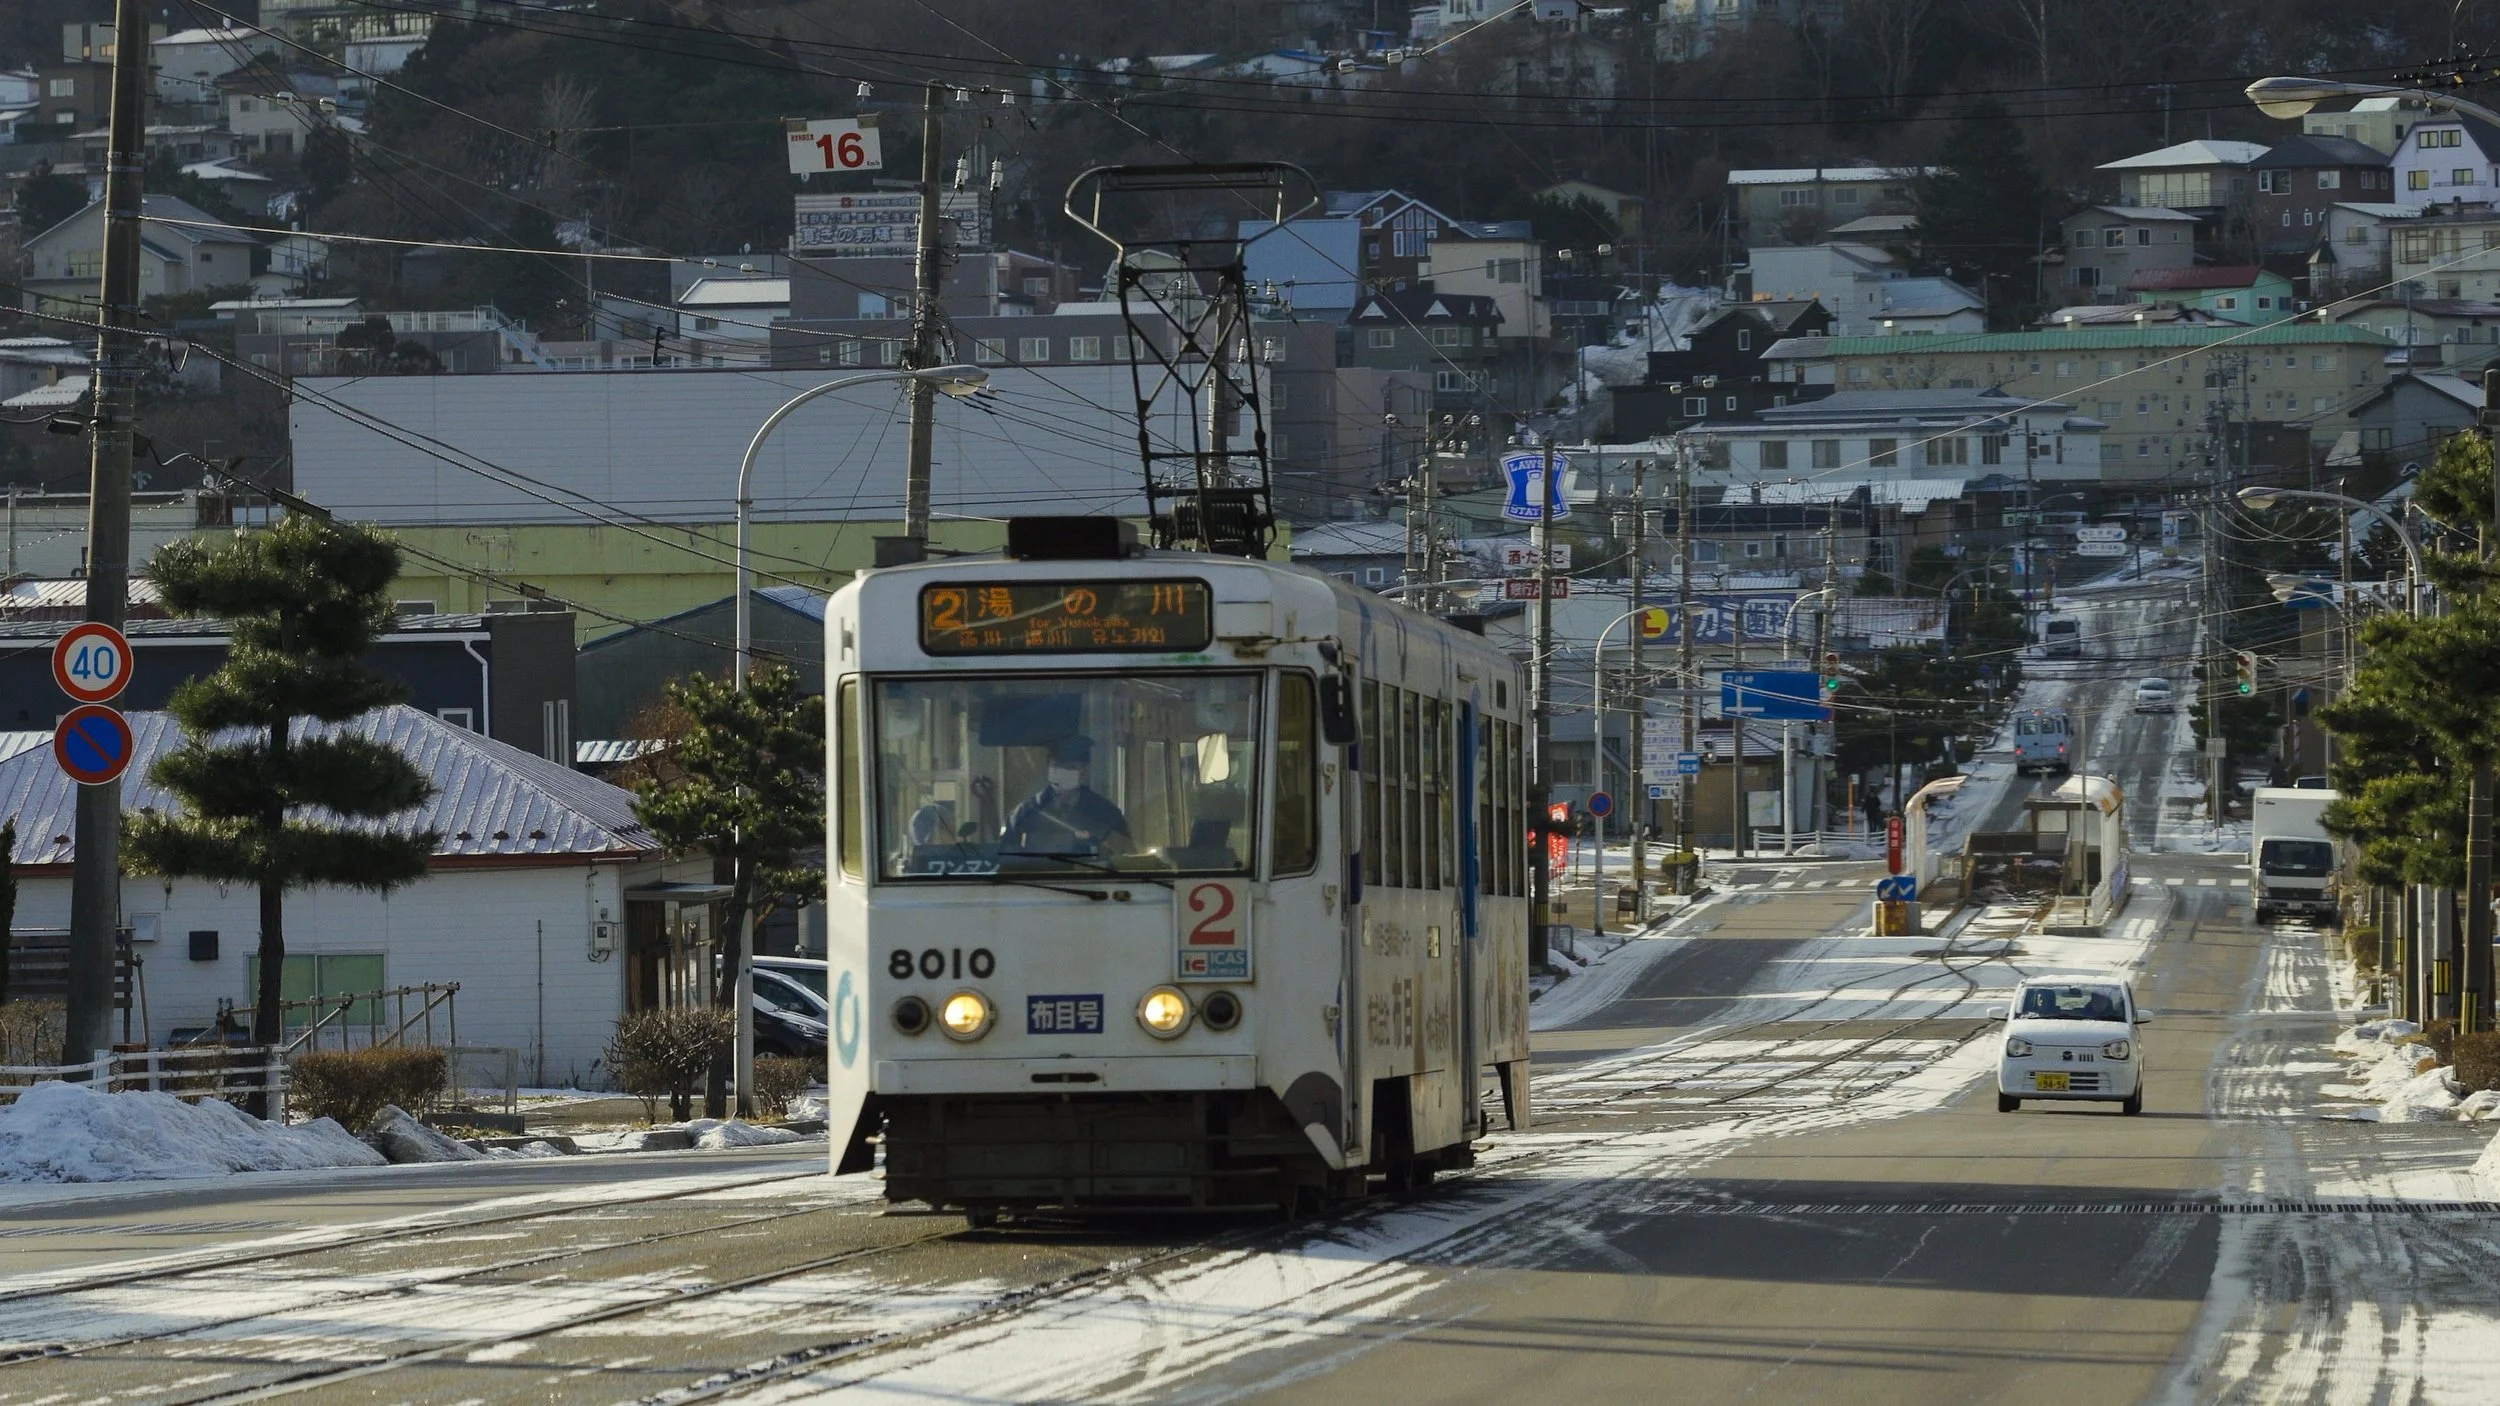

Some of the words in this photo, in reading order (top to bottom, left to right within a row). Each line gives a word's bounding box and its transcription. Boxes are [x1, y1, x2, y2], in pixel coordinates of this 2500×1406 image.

[816, 132, 864, 169] 16
[1509, 459, 1563, 473] LAWSN
[1508, 549, 1565, 565] 酒・たこ
[1510, 581, 1565, 596] 銀行AM
[932, 591, 963, 628] 2
[978, 584, 1185, 617] 湯の川
[72, 645, 114, 680] 40
[927, 860, 1000, 873] ワンマン
[1188, 882, 1236, 945] 2
[888, 947, 996, 980] 8010
[1210, 951, 1245, 965] ICAS
[1031, 1000, 1101, 1031] 布目号
